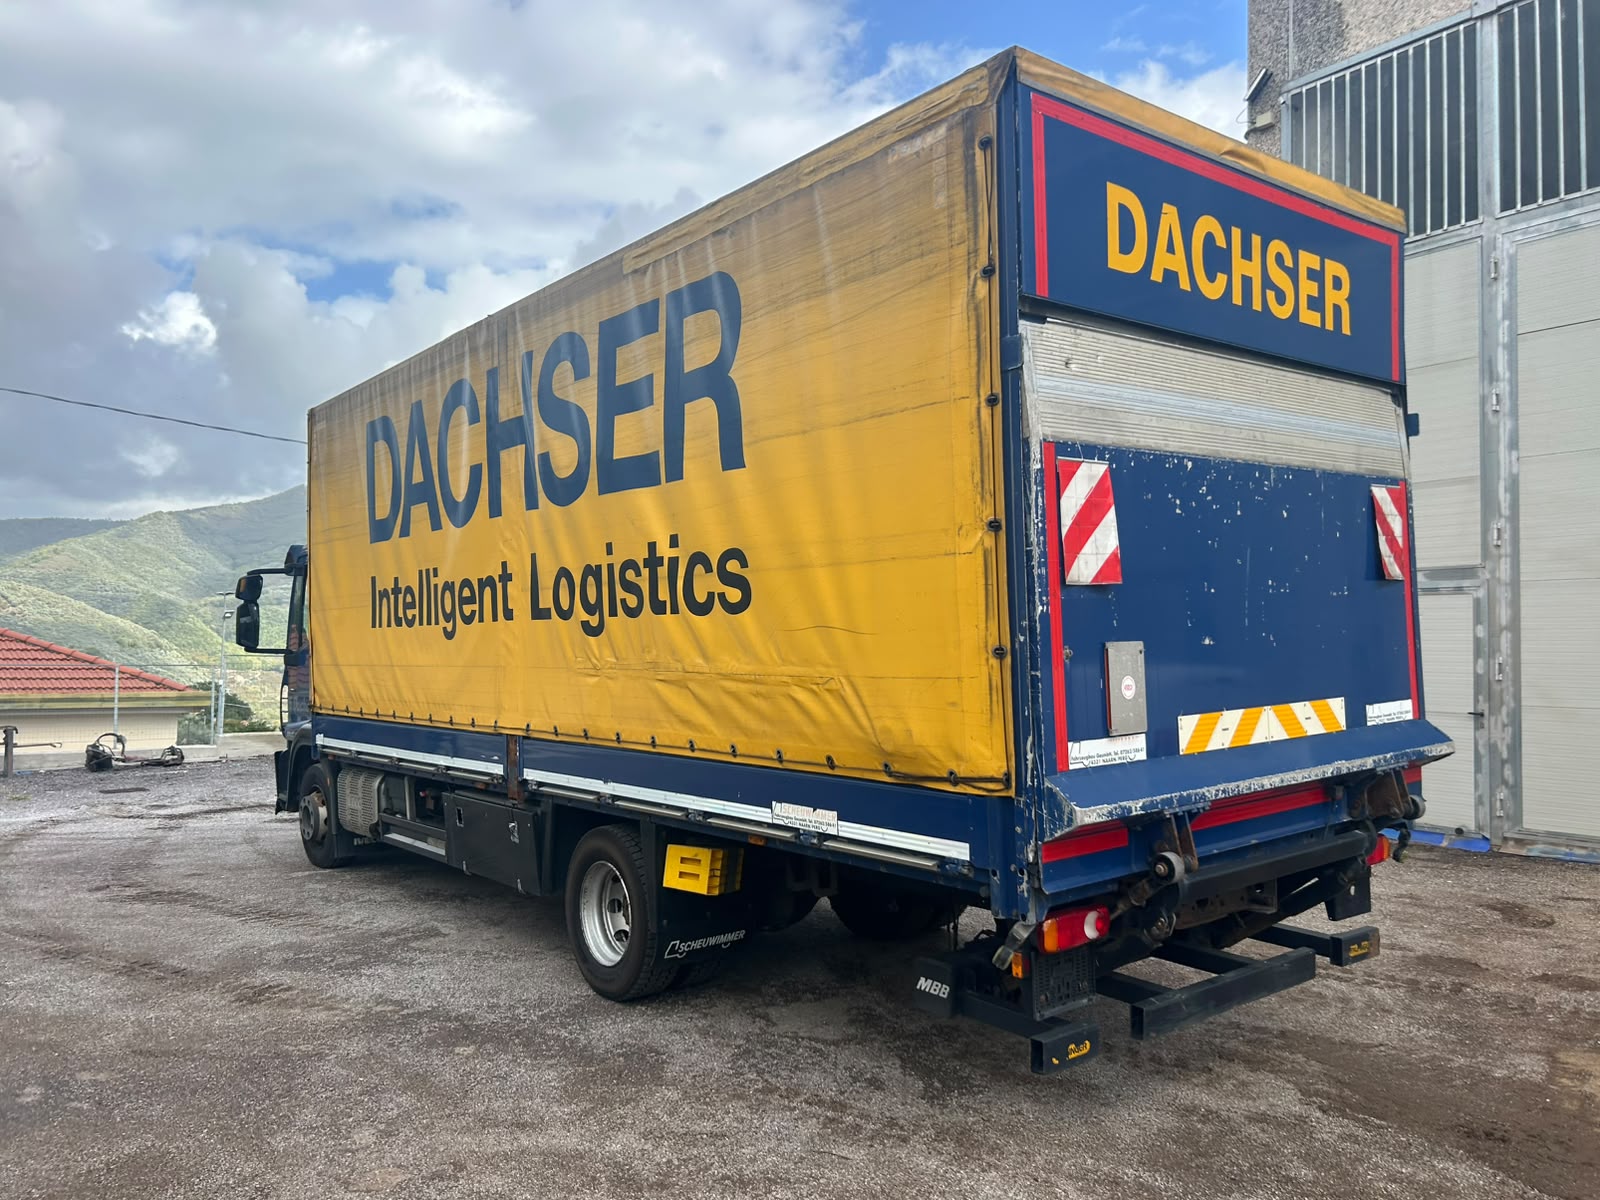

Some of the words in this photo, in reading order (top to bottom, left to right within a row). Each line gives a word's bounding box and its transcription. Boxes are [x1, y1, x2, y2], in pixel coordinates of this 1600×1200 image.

[1106, 181, 1351, 336] DACHSER
[366, 270, 747, 545] DACHSER
[370, 560, 514, 641] Intelligent
[530, 533, 752, 638] Logistics
[678, 929, 746, 953] SCHEUWIMMER
[916, 976, 951, 999] MBB
